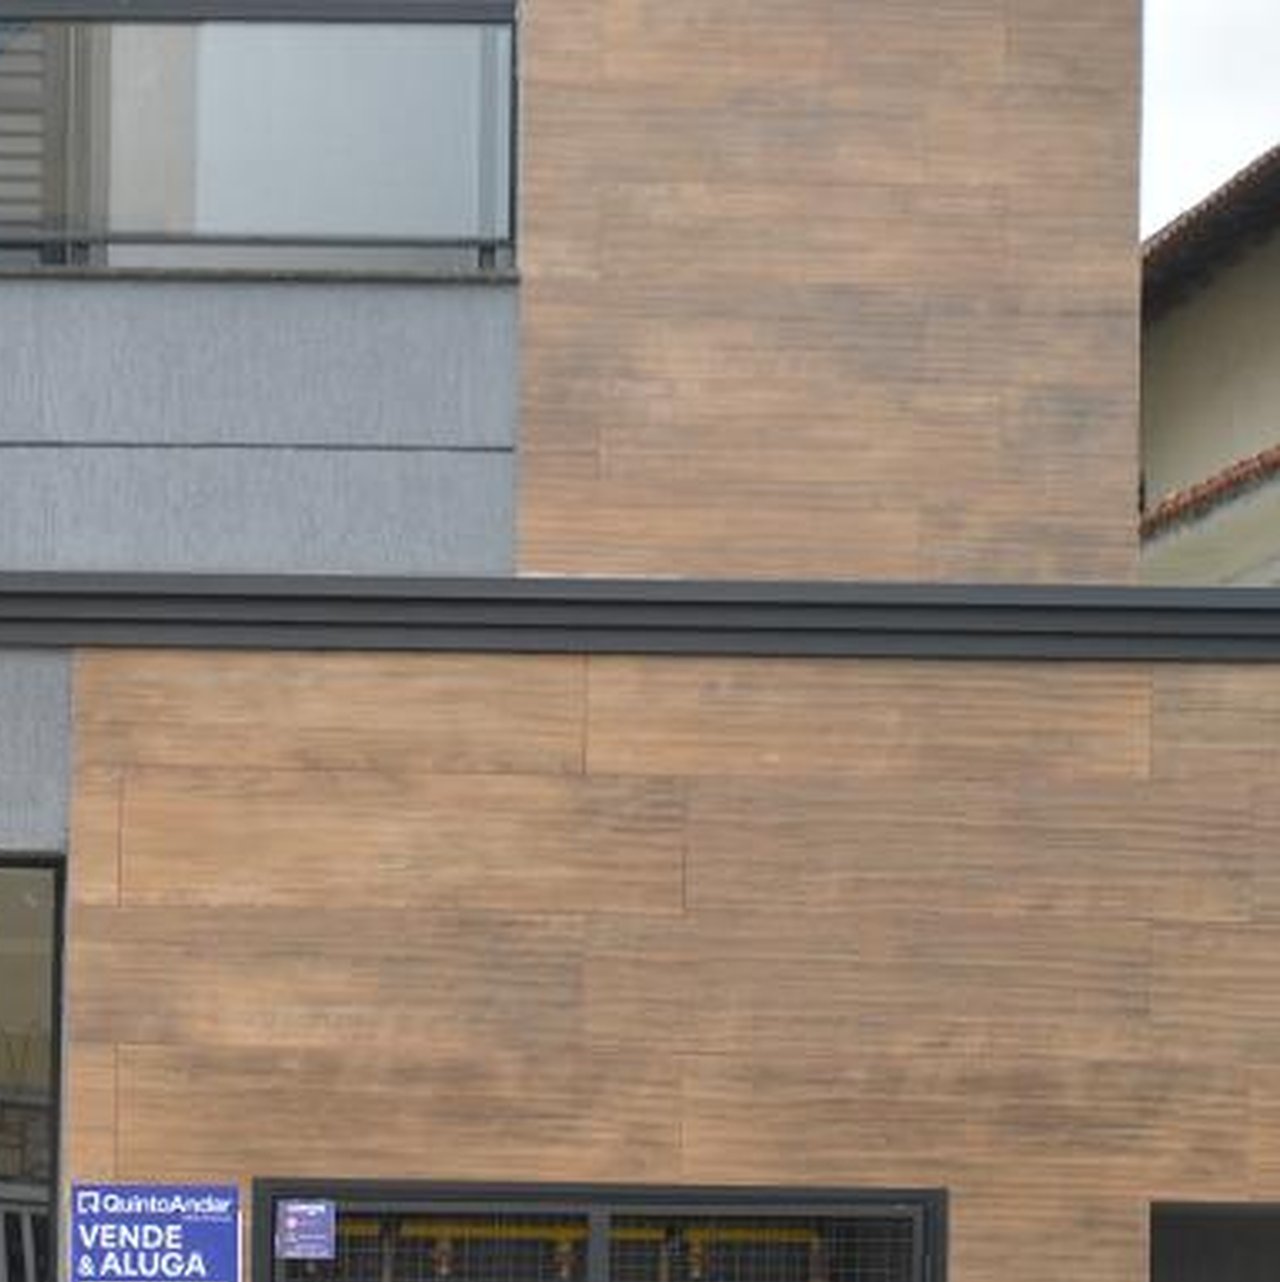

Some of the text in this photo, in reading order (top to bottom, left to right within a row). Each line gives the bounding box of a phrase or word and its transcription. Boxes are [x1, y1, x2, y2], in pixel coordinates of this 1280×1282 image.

[102, 1192, 232, 1215] QuintoAndar
[78, 1223, 184, 1250] VENDE
[77, 1252, 207, 1278] & ALUGA
